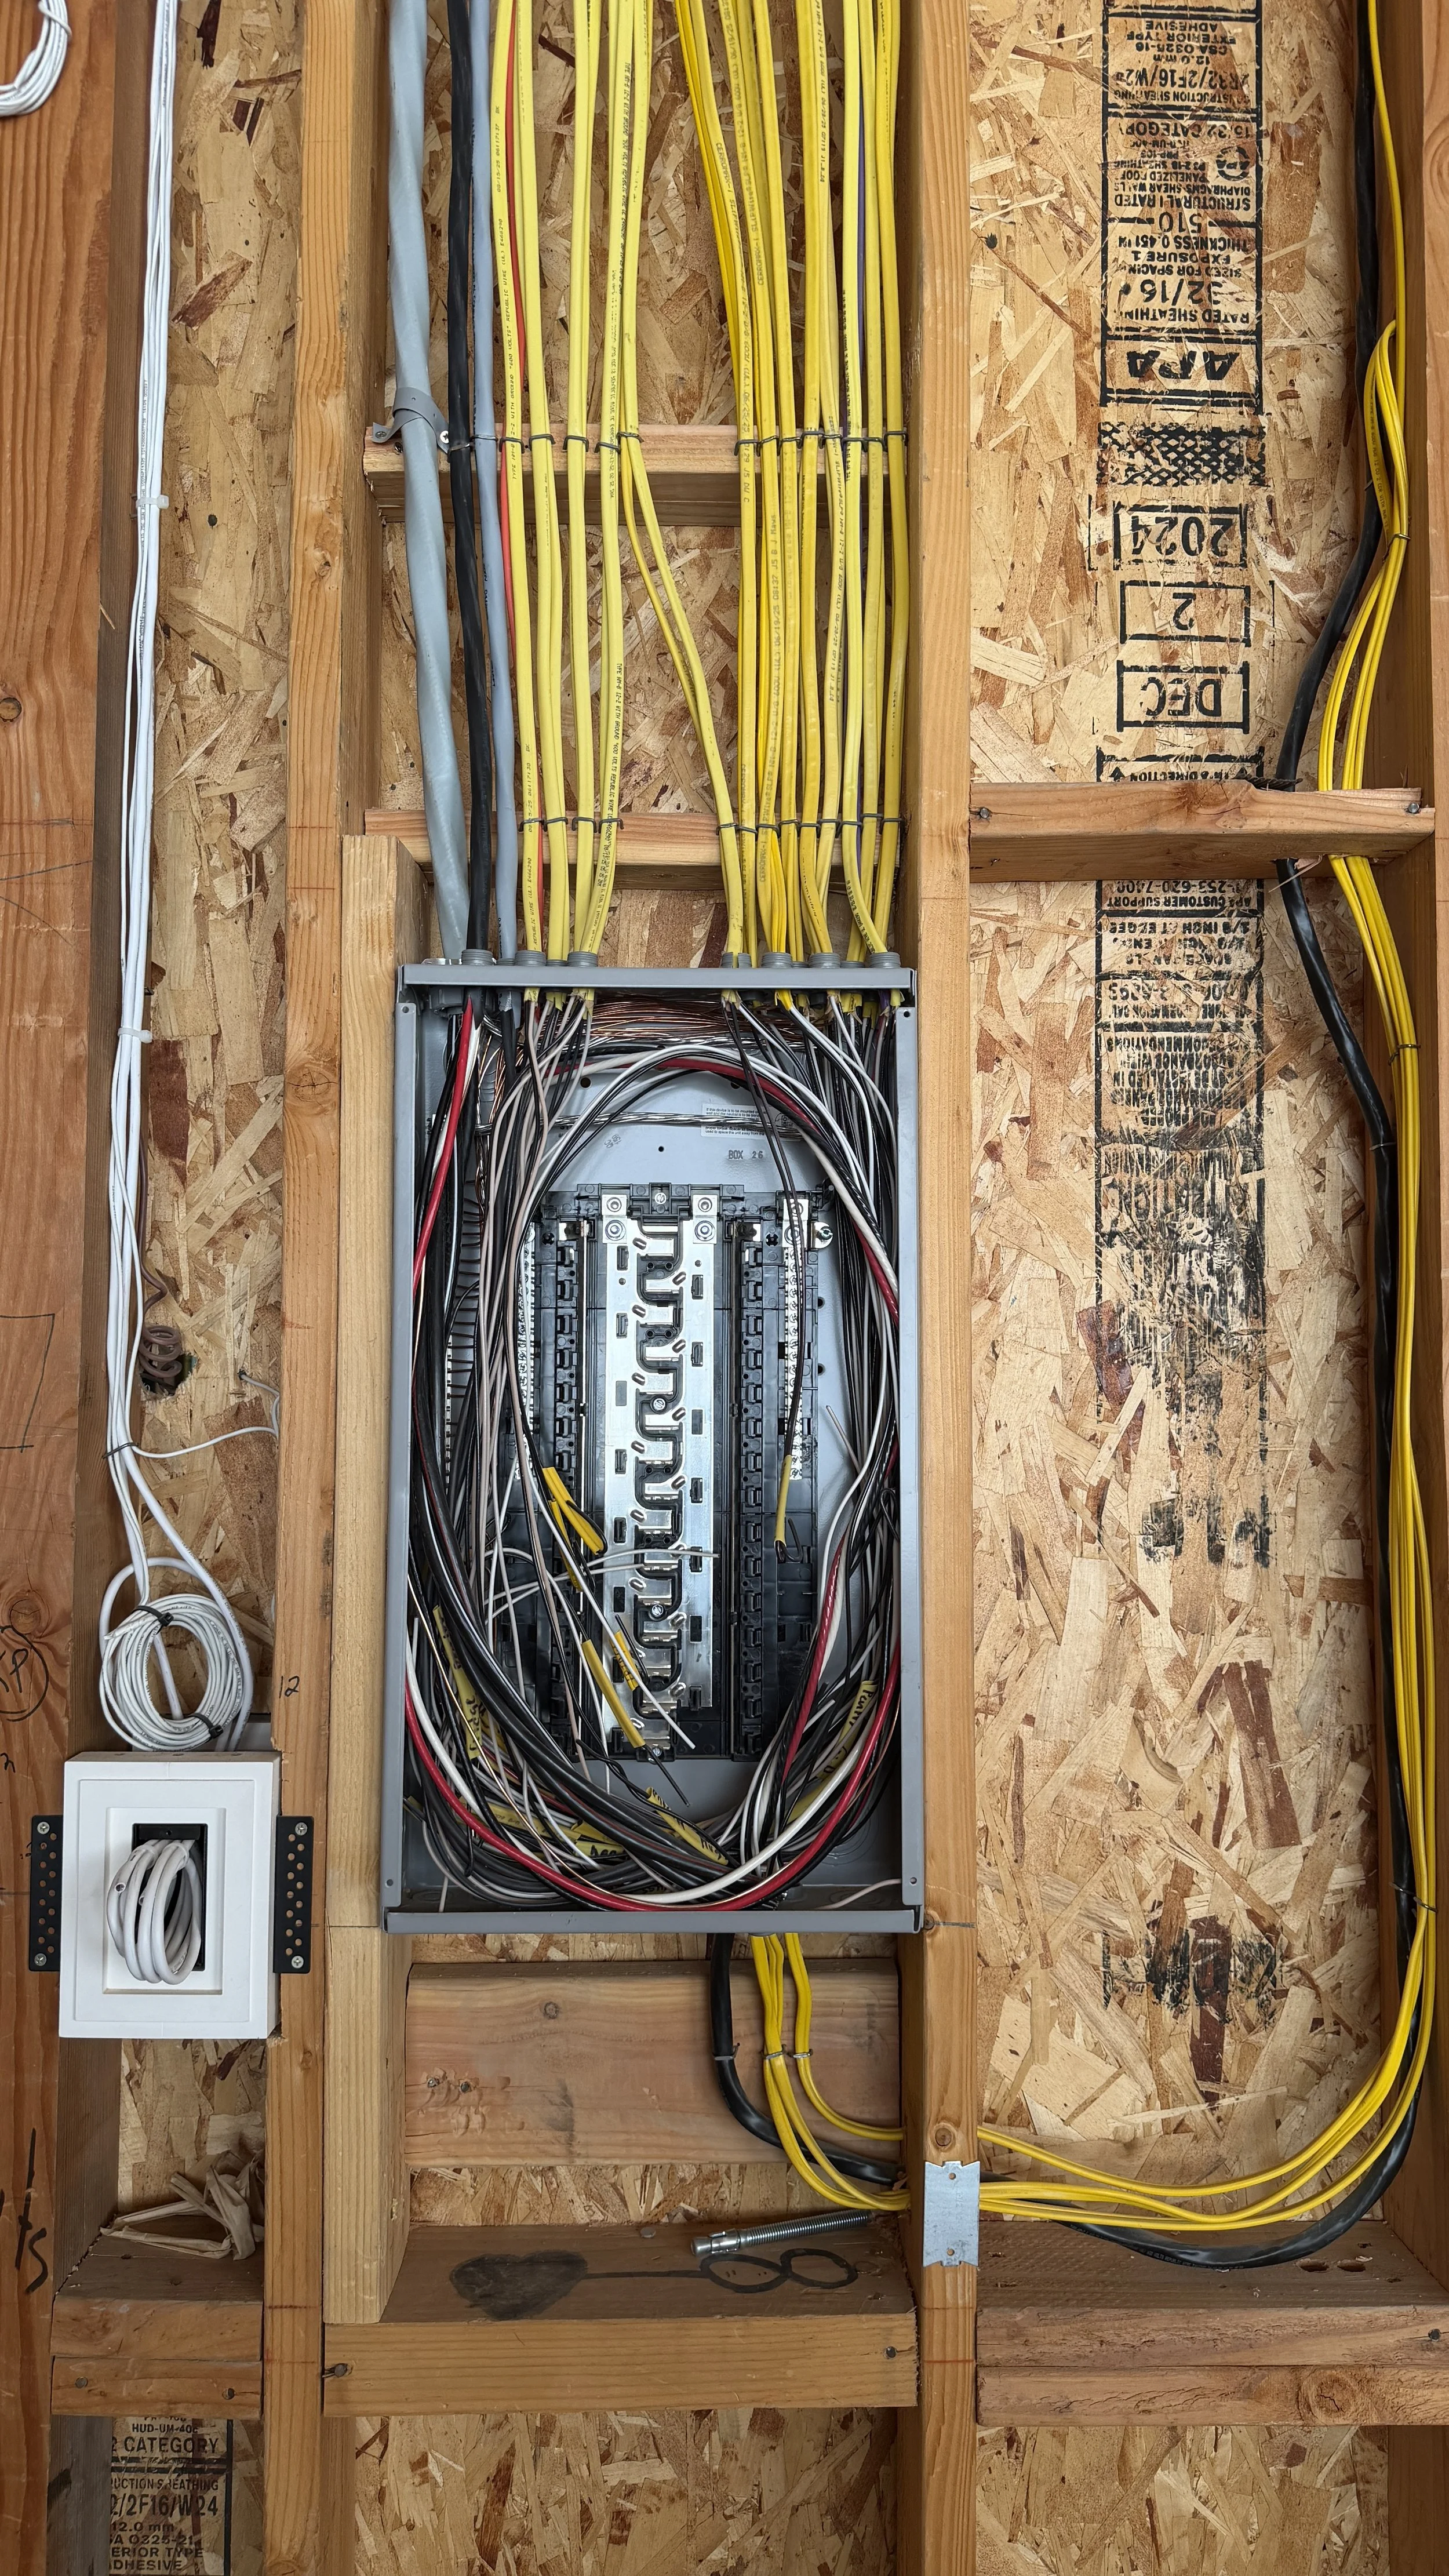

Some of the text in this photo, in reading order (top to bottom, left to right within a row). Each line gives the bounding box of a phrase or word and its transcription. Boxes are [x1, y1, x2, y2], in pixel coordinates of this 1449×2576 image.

[1145, 20, 1218, 32] ADHESIVE
[726, 23, 737, 60] 06/19/25
[1166, 33, 1236, 45] EXTERIOR
[1199, 45, 1228, 56] CSA
[1181, 55, 1210, 66] 12.0
[1115, 194, 1250, 211] STRUCTURAL I RATED
[1159, 212, 1202, 233] 510
[1135, 235, 1170, 249] 0.451
[1174, 236, 1248, 252] THICKNESS
[754, 238, 764, 286] CERROMAX-1
[1131, 250, 1230, 264] EXPOSURE 1
[1177, 265, 1201, 276] FOR
[1140, 279, 1222, 306] 32/16
[1113, 307, 1249, 324] RATED SHEATHIN
[1127, 350, 1240, 381] APA
[744, 468, 751, 478] J5
[1130, 516, 1233, 556] 2024
[770, 559, 778, 569] J5
[771, 574, 780, 601] 08:37
[1172, 592, 1196, 631] 2
[772, 605, 781, 646] 06/19/25
[1139, 677, 1222, 717] DEC
[609, 774, 617, 798] REPUBLIC
[759, 841, 767, 883] CERROMAX-1
[1107, 897, 1160, 907] SUPPORT
[1164, 896, 1225, 907] CUSTOMER
[1182, 922, 1217, 934] INCH
[729, 1149, 763, 1159] BOX 26
[279, 1675, 300, 1699] 12
[124, 2436, 219, 2453] CATEGORY
[111, 2478, 219, 2491] UCTION SHEATHING
[149, 2523, 174, 2533] mm
[165, 2547, 203, 2557] TYPE
